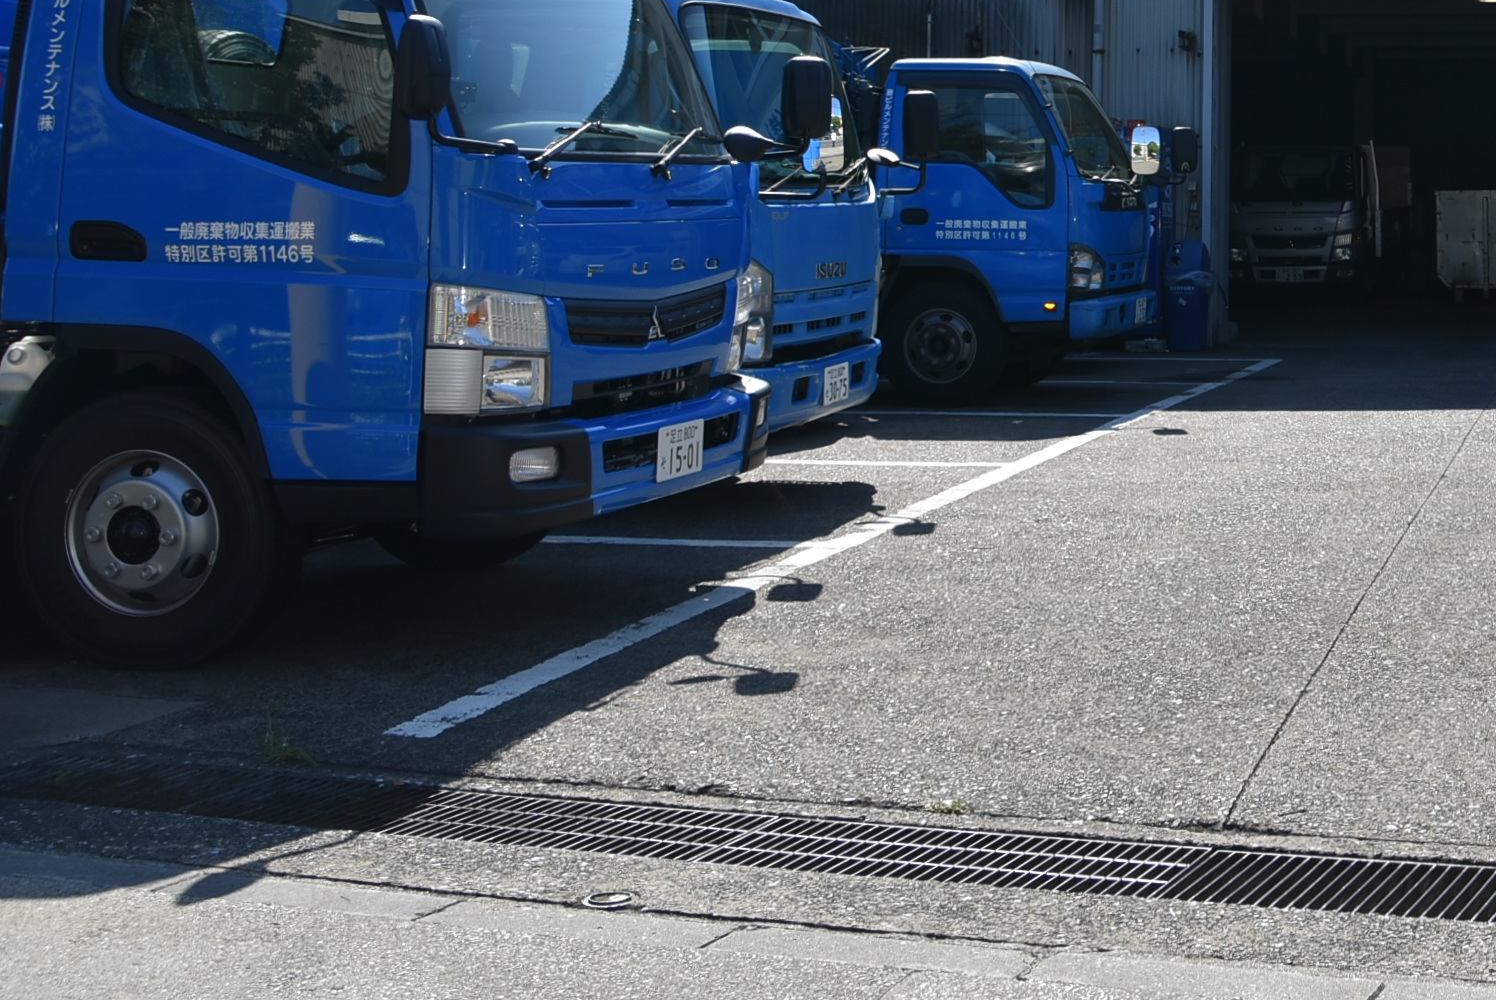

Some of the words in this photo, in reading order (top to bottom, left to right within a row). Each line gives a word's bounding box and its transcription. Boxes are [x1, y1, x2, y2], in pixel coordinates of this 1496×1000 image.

[881, 88, 894, 149] ビルメンテナン
[165, 221, 316, 240] 一般廃棄物収集運搬業
[165, 245, 315, 263] 特別区許可第1146号
[587, 257, 721, 278] FUSO
[815, 261, 847, 279] ISUZU
[669, 441, 699, 475] 15-01
